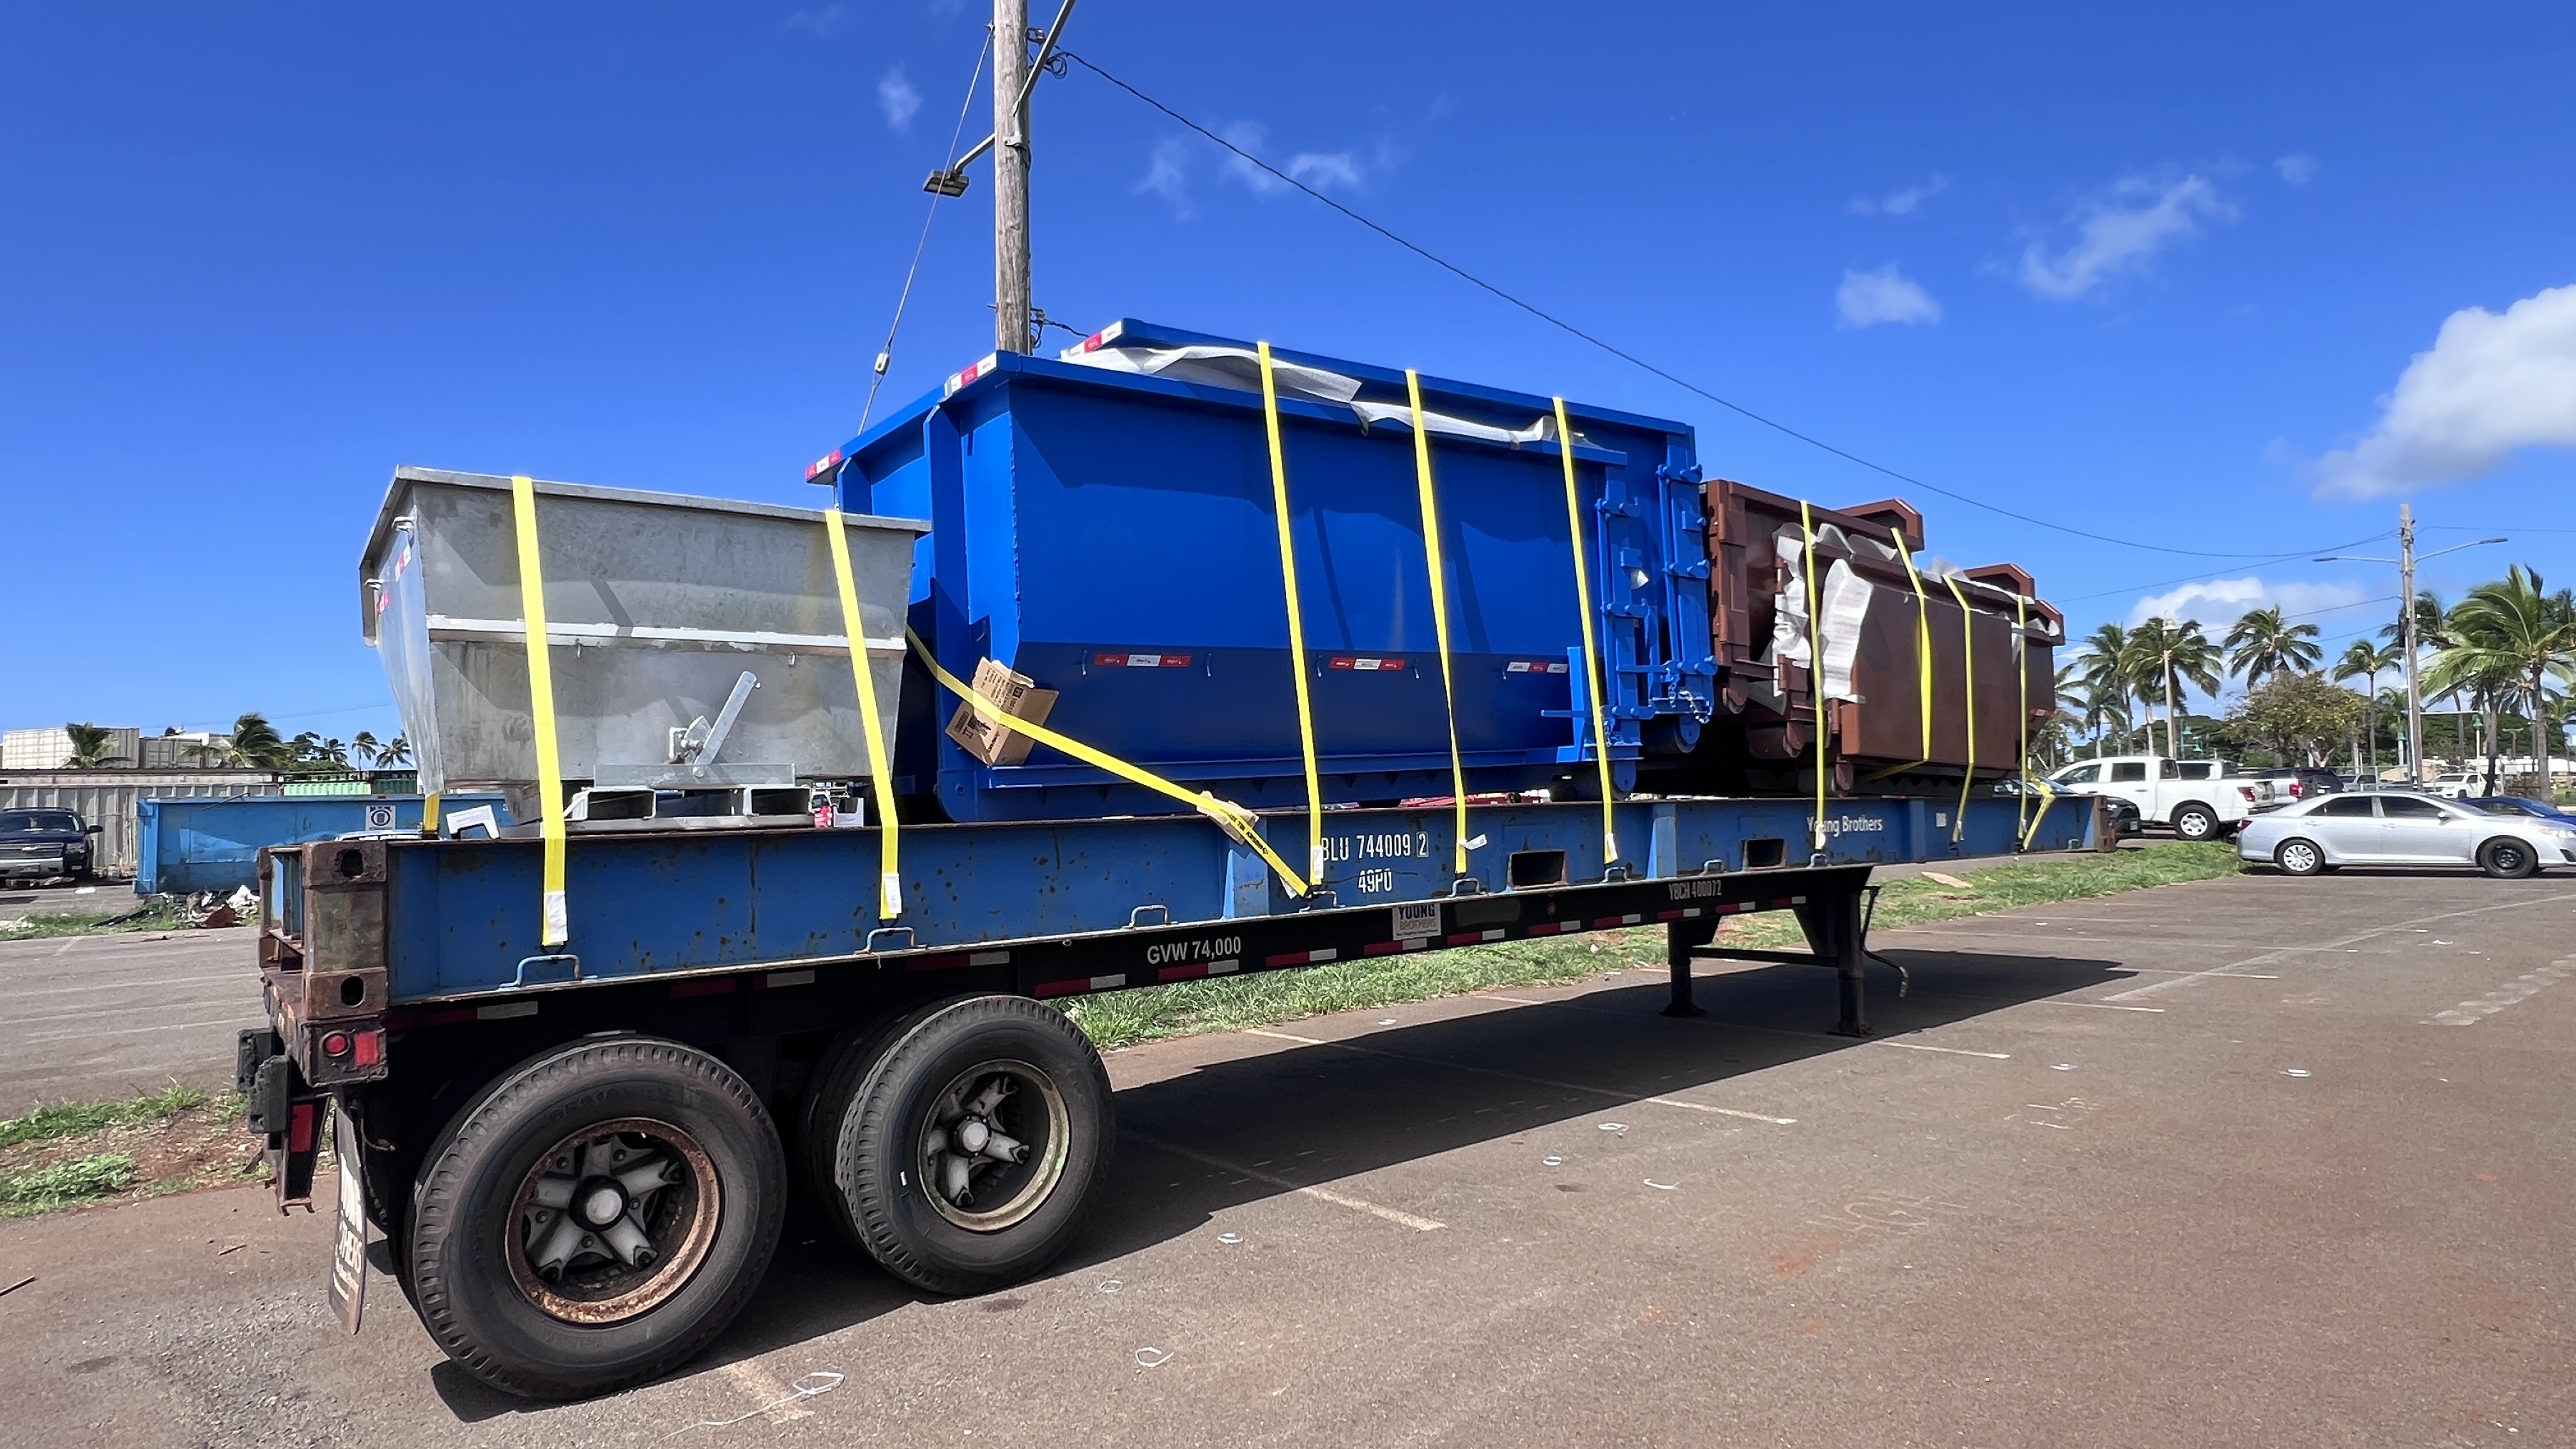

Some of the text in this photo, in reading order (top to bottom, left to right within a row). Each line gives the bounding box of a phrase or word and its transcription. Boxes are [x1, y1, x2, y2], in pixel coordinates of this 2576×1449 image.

[1842, 815, 1882, 832] Brothers
[1356, 834, 1411, 859] 744009
[1417, 832, 1428, 857] 2
[1399, 903, 1435, 920] YOUNG
[1147, 936, 1241, 964] GVW 74,000
